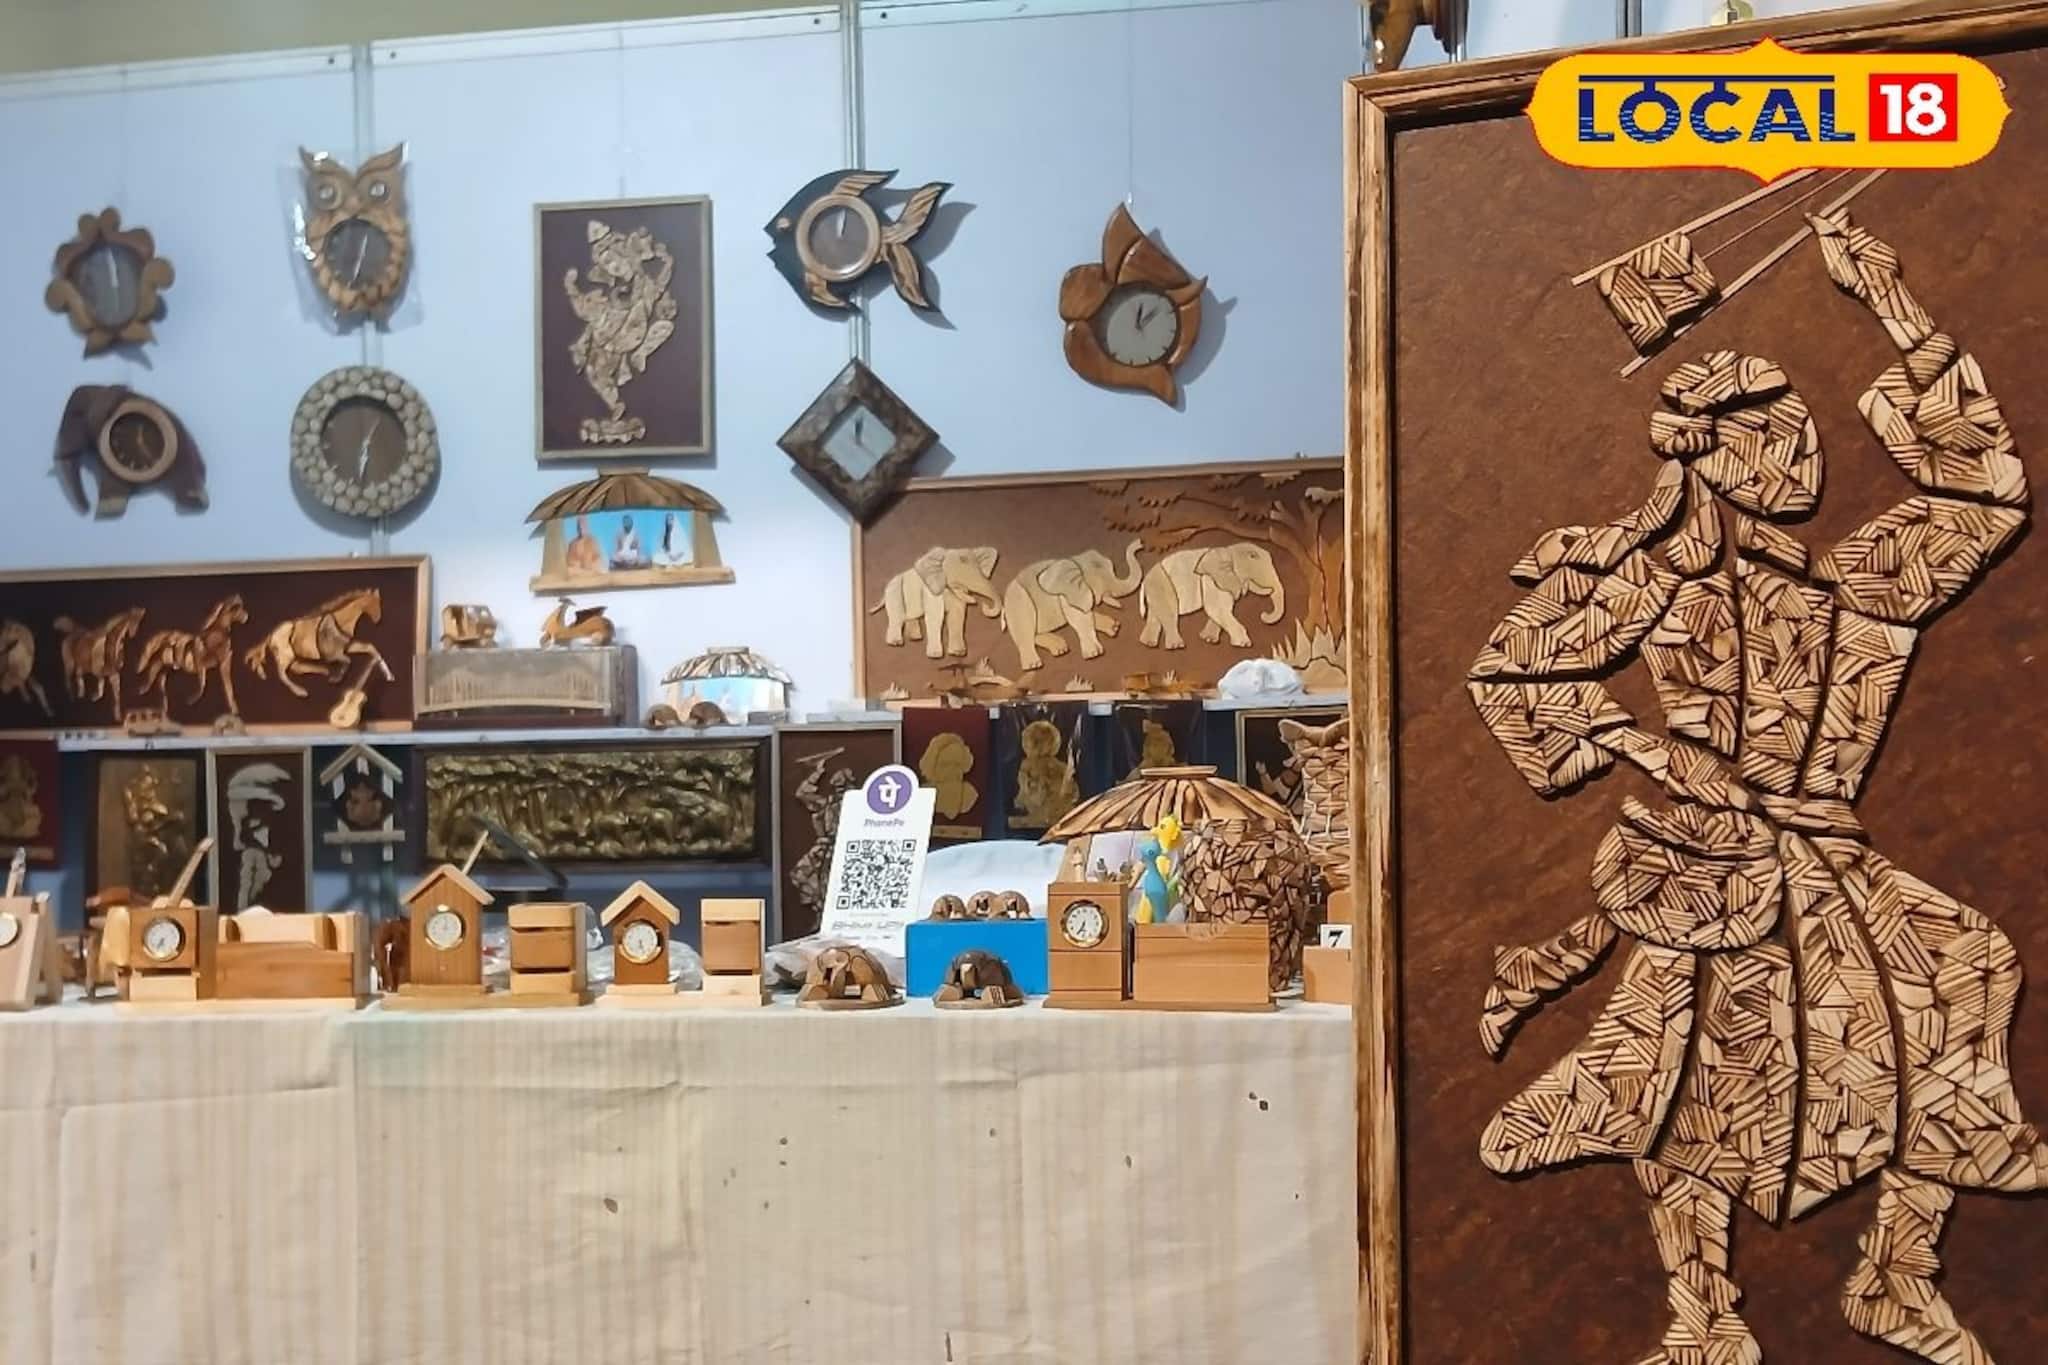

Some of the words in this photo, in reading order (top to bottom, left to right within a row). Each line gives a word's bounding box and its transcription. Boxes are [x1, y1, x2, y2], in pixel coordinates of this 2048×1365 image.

[878, 775, 902, 808] पे
[864, 818, 905, 827] PhonePe
[1328, 929, 1344, 948] 7
